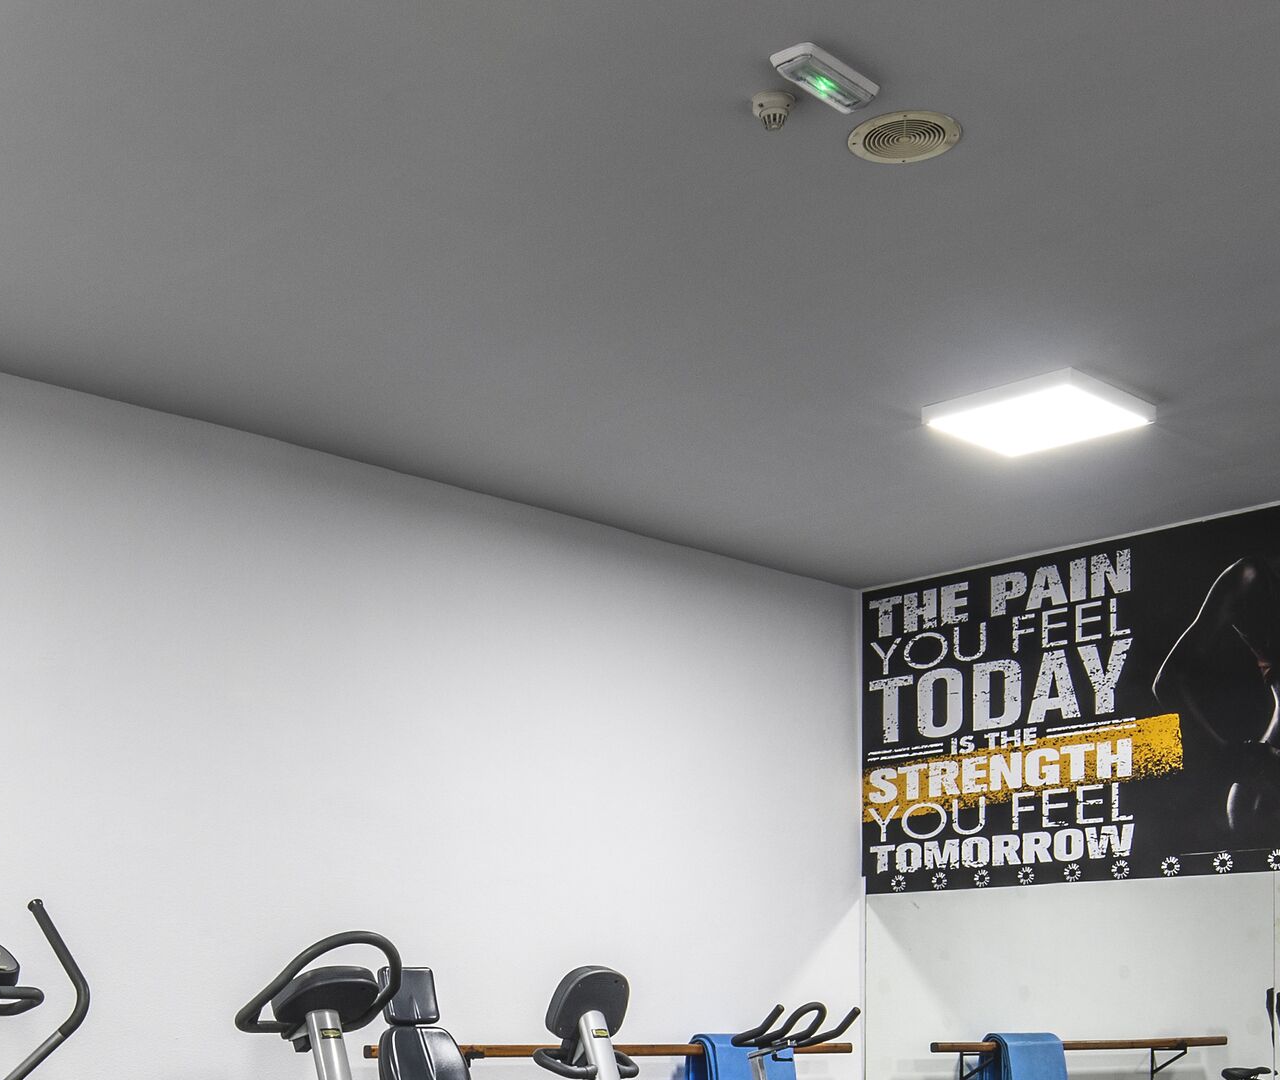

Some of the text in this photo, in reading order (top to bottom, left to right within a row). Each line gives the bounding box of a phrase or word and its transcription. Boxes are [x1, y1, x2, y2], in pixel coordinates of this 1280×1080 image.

[869, 548, 1131, 638] THE PAIN
[870, 598, 1131, 675] YOU FEEL
[869, 638, 1133, 743] TODAY
[869, 738, 1132, 804] STRENGTH
[950, 727, 1038, 756] IS THE
[868, 783, 1134, 842] YOU FEEL
[870, 824, 1135, 874] TOMORROW
